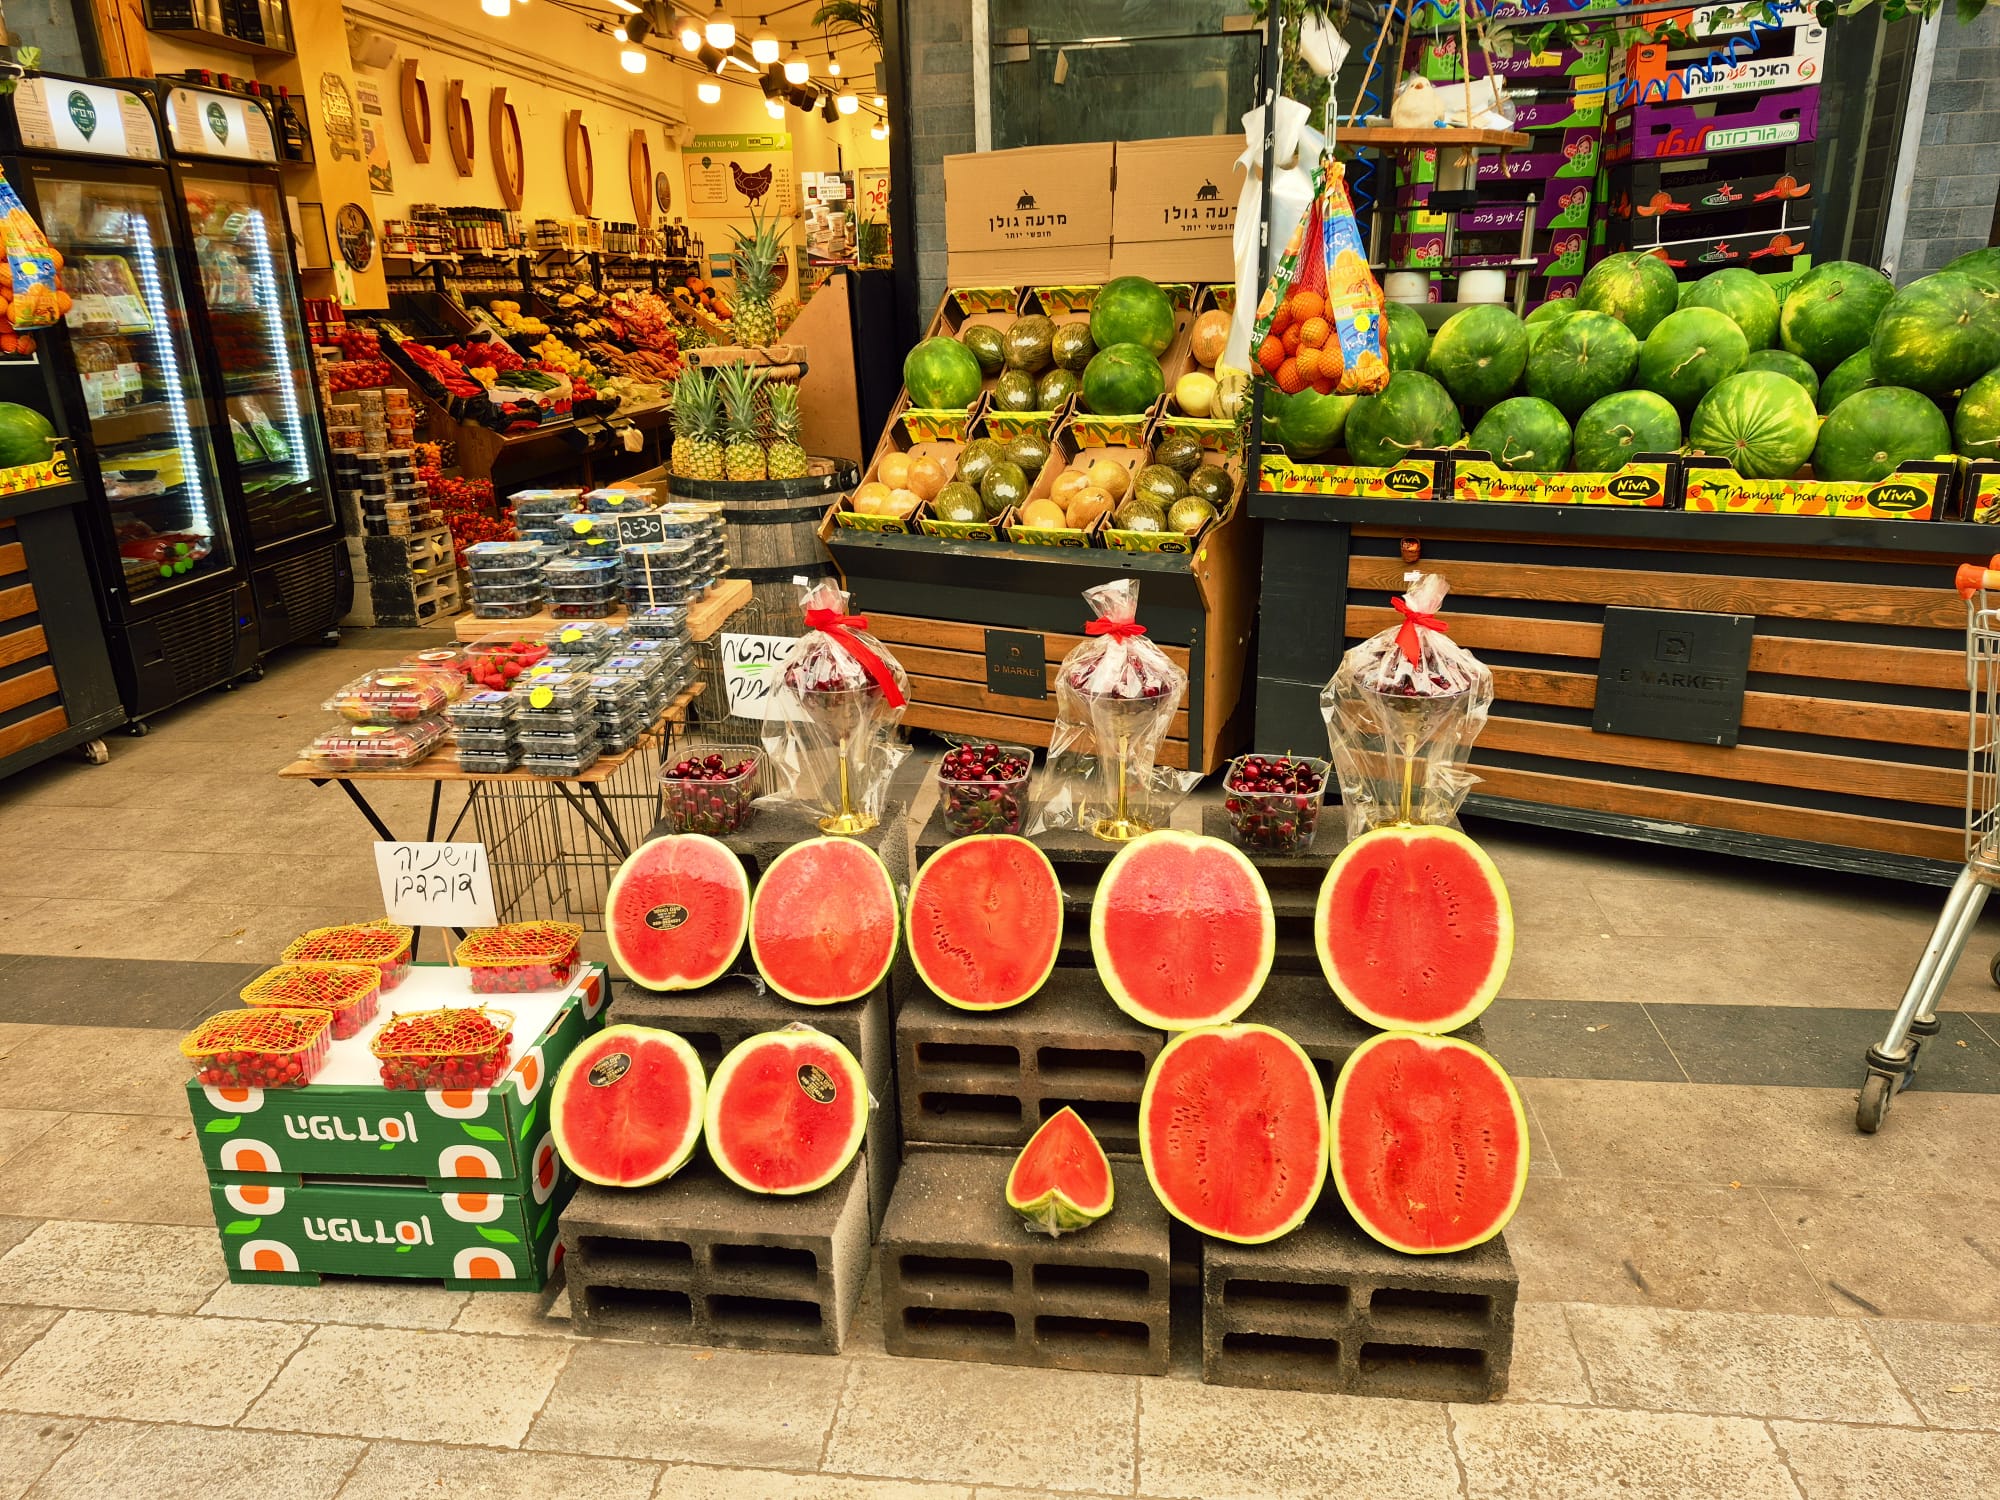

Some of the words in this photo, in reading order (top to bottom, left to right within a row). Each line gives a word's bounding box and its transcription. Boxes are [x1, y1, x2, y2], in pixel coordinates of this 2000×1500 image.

[1749, 63, 1790, 79] האיכר
[988, 214, 1020, 233] גולן
[1025, 213, 1068, 228] מרעה
[1164, 206, 1199, 225] גולן
[1004, 230, 1023, 239] יותר
[1025, 229, 1052, 239] חופשי
[1180, 224, 1201, 232] יותר
[1278, 470, 1326, 486] Mangue
[1329, 472, 1349, 487] par
[1352, 473, 1383, 486] avion
[1484, 478, 1538, 496] Mangue
[1543, 481, 1566, 496] par
[1570, 483, 1606, 495] avion
[1724, 484, 1786, 504] Mangue
[1791, 489, 1817, 505] par
[1825, 490, 1865, 504] avion
[993, 664, 1001, 673] D
[1002, 665, 1041, 678] MARKET
[1640, 671, 1729, 691] MARKET
